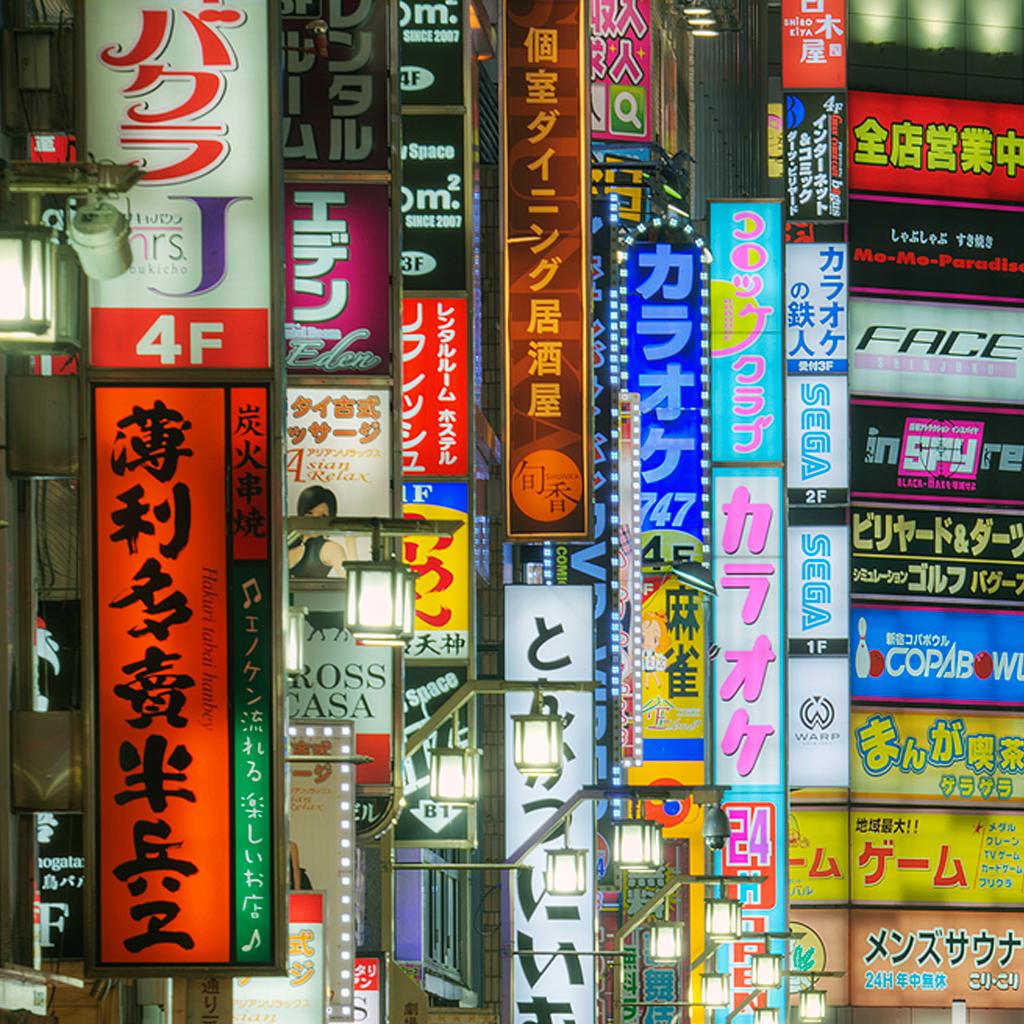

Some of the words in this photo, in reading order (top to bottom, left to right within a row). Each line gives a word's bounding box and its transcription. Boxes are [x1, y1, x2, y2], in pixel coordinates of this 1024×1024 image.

[403, 29, 433, 43] SINCE
[434, 29, 461, 43] 2007
[822, 94, 844, 114] 4F
[409, 143, 455, 160] Space
[798, 131, 814, 206] &コミック
[812, 113, 829, 216] インターネット
[406, 215, 434, 228] SINCE
[435, 215, 461, 228] 2007
[523, 27, 563, 418] 個室ダイニング居酒屋
[890, 227, 949, 247] しゃぶしゃぶ
[955, 231, 995, 251] すき焼き
[291, 190, 350, 323] エデン
[787, 281, 816, 358] の鉄人
[818, 246, 846, 357] カラオケ
[135, 314, 225, 365] 4F
[285, 328, 383, 372] Eden
[436, 302, 457, 402] レンタルルーム
[636, 243, 696, 485] カラオケ
[797, 359, 834, 372] 受付3F
[877, 356, 996, 377] SHINJUKU
[290, 395, 382, 420] タイ古式
[437, 409, 459, 466] ホステル
[800, 382, 831, 481] SEGA
[232, 403, 267, 540] 炭火串焼
[306, 470, 373, 484] Relax
[545, 473, 581, 482] SHUNKA
[804, 489, 828, 505] 2F
[202, 566, 219, 623] Hakuri
[801, 533, 832, 632] SEGA
[908, 562, 967, 595] ゴルフ
[664, 585, 701, 699] 麻雀
[718, 485, 777, 778] カラオケ
[806, 640, 828, 654] 1F
[199, 663, 218, 732] hanbey
[794, 732, 842, 742] WARP
[939, 775, 1014, 800] ゲラゲラ
[726, 807, 772, 866] 24
[855, 817, 920, 835] 地域最大!!
[985, 835, 1020, 847] クレーン
[988, 822, 1017, 834] メダル
[857, 838, 970, 890] ゲーム
[984, 850, 1021, 861] TVゲーム
[978, 877, 1013, 889] プリクラ
[864, 927, 1022, 966] メンズサウナ
[865, 971, 894, 990] 24H
[896, 972, 948, 992] 年中無休
[968, 971, 1020, 991] こり・こり
